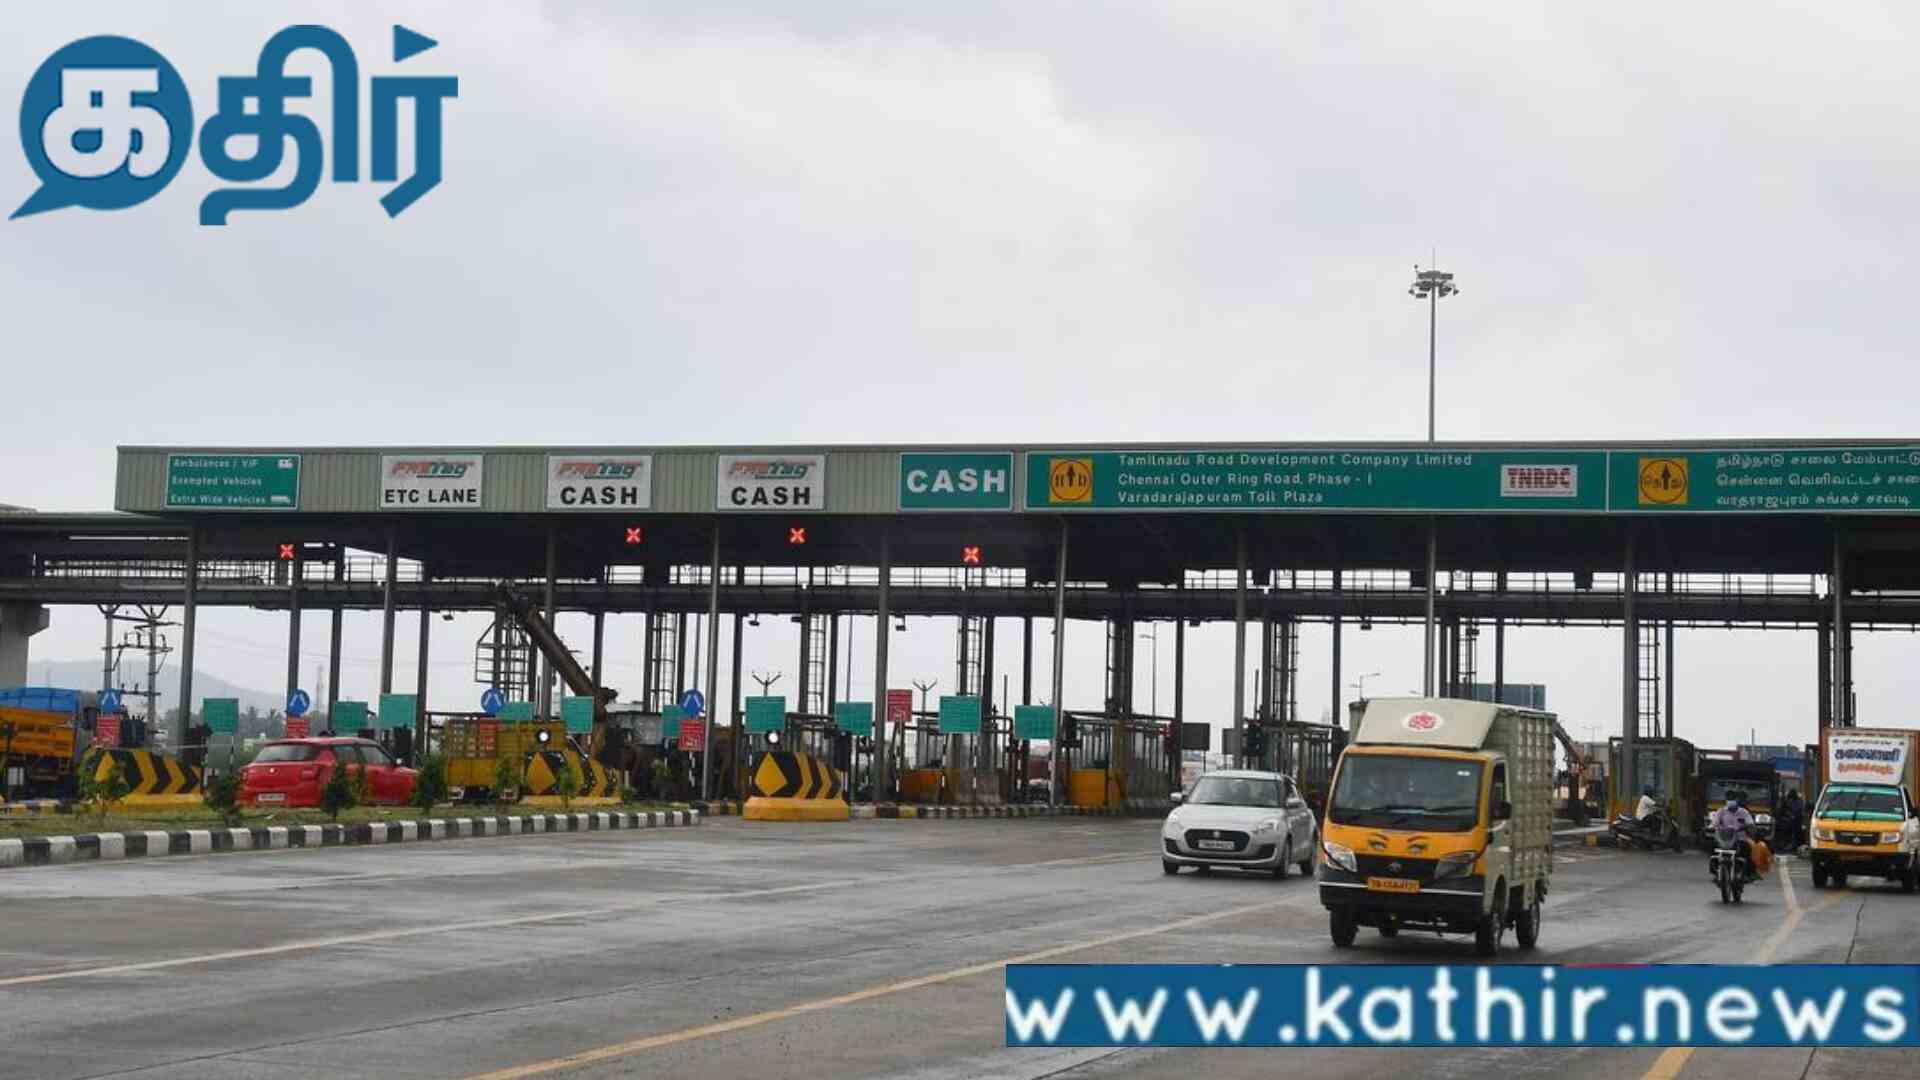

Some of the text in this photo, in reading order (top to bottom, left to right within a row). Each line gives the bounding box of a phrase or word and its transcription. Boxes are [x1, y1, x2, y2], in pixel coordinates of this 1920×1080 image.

[1119, 454, 1472, 467] Tamilnadu Road Development Company Limited
[223, 477, 262, 486] Vehicles
[907, 468, 1005, 493] CASH
[1118, 473, 1175, 485] Chennai
[1180, 473, 1220, 485] Outer
[1228, 472, 1258, 487] Ring
[1308, 473, 1351, 485] Phase
[1507, 467, 1571, 489] TNRDC
[199, 495, 223, 504] Wide
[228, 495, 266, 504] Vehicles
[385, 489, 477, 503] ETC LANE
[560, 485, 637, 505] CASH
[731, 485, 810, 505] CASH
[1118, 491, 1323, 504] Varadarajapuram Toll Plaza
